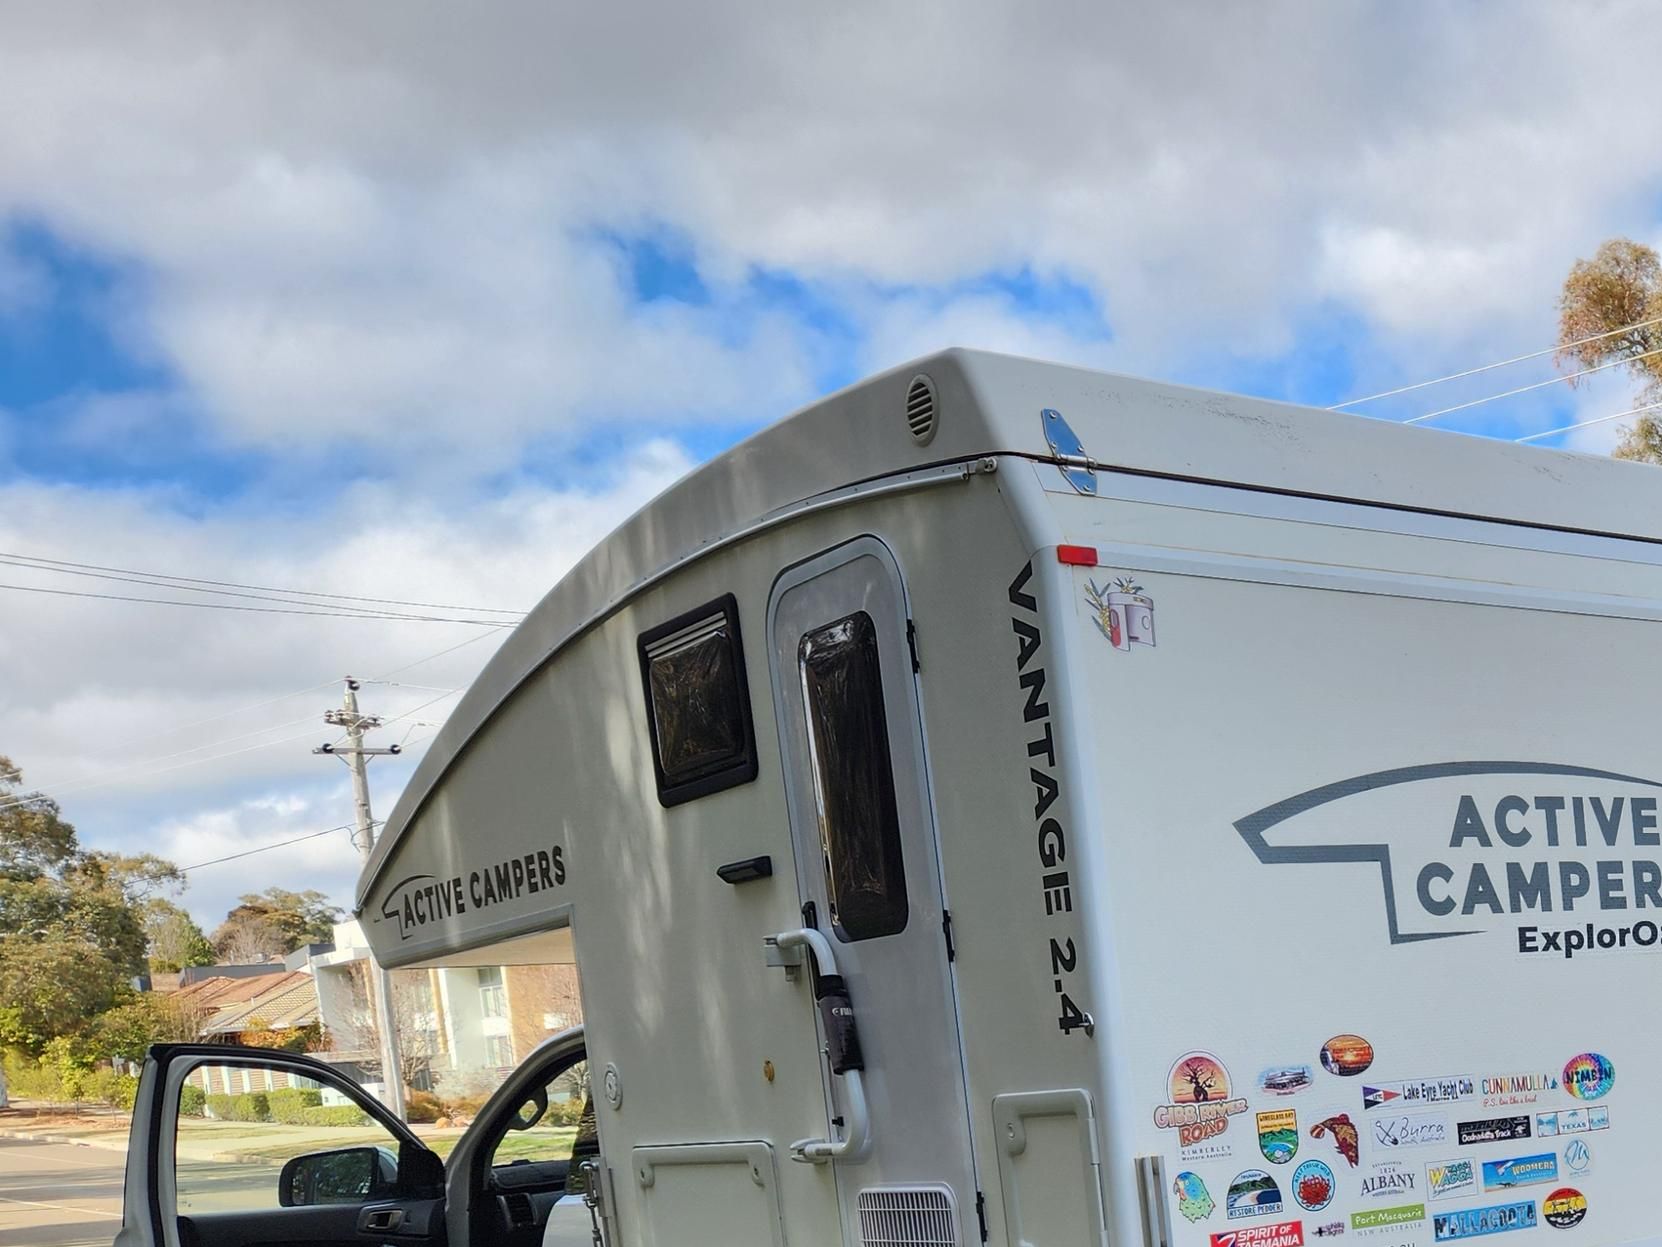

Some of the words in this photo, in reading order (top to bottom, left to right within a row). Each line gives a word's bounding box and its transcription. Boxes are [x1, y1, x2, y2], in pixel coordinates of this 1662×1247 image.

[1008, 560, 1073, 916] VANTAGE
[1049, 936, 1084, 1036] 2.4
[1449, 794, 1661, 848] ACTIVE
[403, 876, 466, 930] ACTIVE
[469, 845, 566, 909] CAMPERS
[1481, 1074, 1550, 1095] CUNNAMULLA
[1565, 1067, 1612, 1084] NIMBIN
[1402, 1083, 1420, 1100] Lake
[1421, 1082, 1437, 1102] Eyre
[1437, 1080, 1457, 1098] Yacht
[1458, 1078, 1474, 1095] Club
[1154, 1105, 1199, 1129] GIBB
[1198, 1098, 1249, 1122] RIVER
[1179, 1116, 1229, 1147] ROAD
[1400, 1117, 1444, 1140] Burra
[1561, 1122, 1587, 1131] TEXAS
[1181, 1145, 1231, 1156] KIMBERLEY
[1511, 1160, 1556, 1176] WOOMERA
[1360, 1173, 1416, 1196] ALBANY
[1229, 1205, 1256, 1218] RESTORE
[1257, 1204, 1281, 1214] PEDDER
[1355, 1215, 1376, 1225] Port
[1378, 1209, 1422, 1222] Macquarie
[1433, 1204, 1536, 1239] MALLACOOTA
[1237, 1225, 1279, 1242] SPIRIT
[1280, 1224, 1293, 1234] OF
[1379, 1223, 1422, 1233] AUSTRALIA
